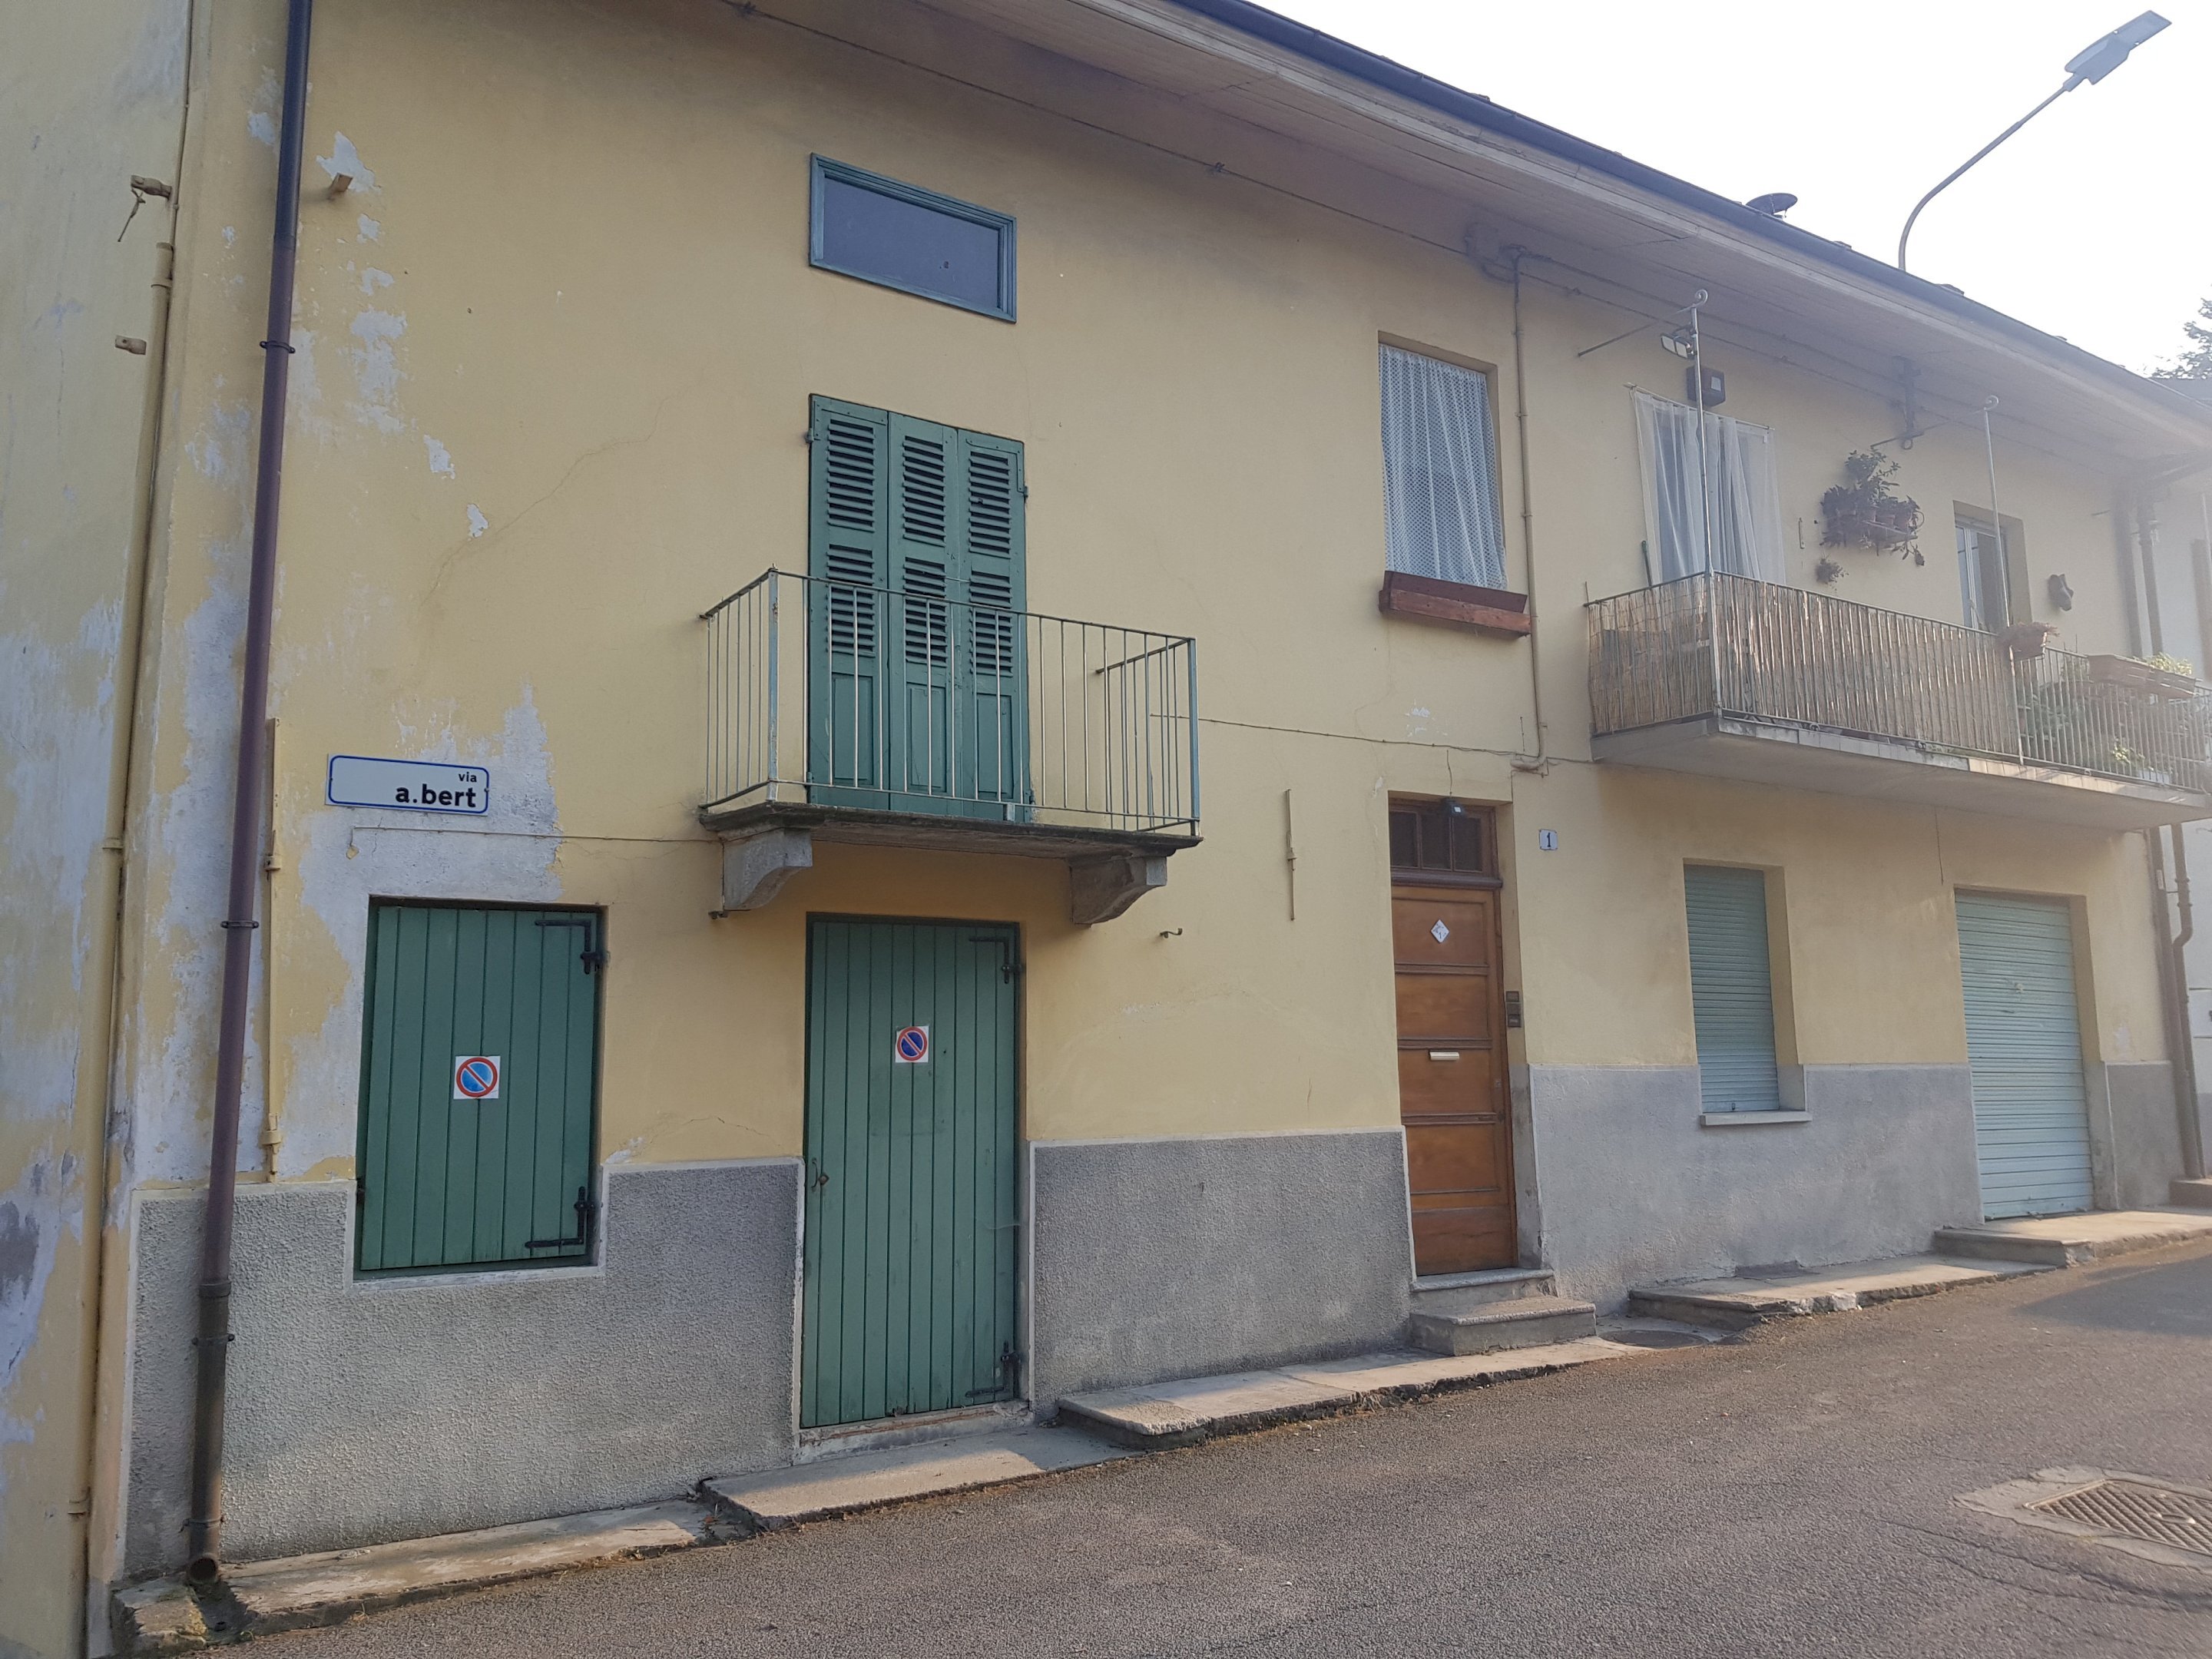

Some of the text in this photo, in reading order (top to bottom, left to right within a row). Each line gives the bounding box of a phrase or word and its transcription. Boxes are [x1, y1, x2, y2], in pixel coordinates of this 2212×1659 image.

[459, 771, 477, 783] via
[396, 783, 476, 808] a.bert
[1546, 832, 1551, 848] 1
